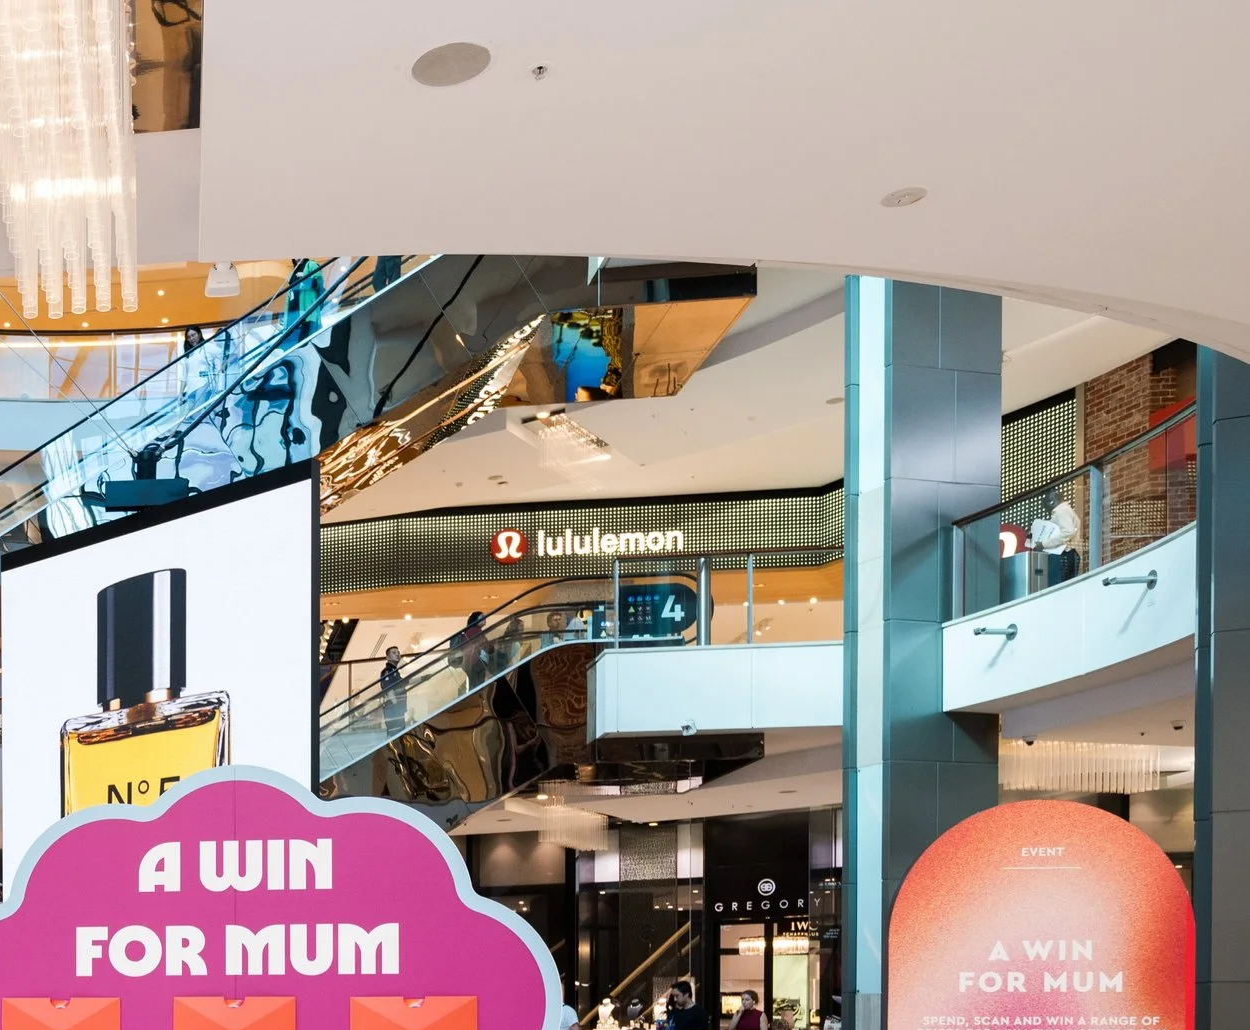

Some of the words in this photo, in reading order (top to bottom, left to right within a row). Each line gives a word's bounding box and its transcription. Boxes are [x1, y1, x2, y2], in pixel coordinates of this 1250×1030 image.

[537, 527, 684, 556] lululemon
[661, 594, 686, 622] 4
[1021, 846, 1066, 857] EVENT
[138, 841, 181, 893] A
[199, 838, 333, 892] WIN
[714, 897, 822, 913] GREGORY
[75, 925, 208, 977] FOR
[225, 922, 400, 976] MUM
[988, 941, 1010, 961] A
[1022, 940, 1093, 961] WIN
[958, 972, 1026, 993] FOR
[1043, 971, 1124, 993] MUM
[923, 1016, 969, 1027] SPEND,
[974, 1016, 1010, 1026] SCAN
[1014, 1016, 1041, 1026] AND
[1046, 1016, 1074, 1026] WIN
[1078, 1016, 1087, 1026] A
[1091, 1016, 1137, 1026] RANGE
[1141, 1016, 1160, 1026] OF
